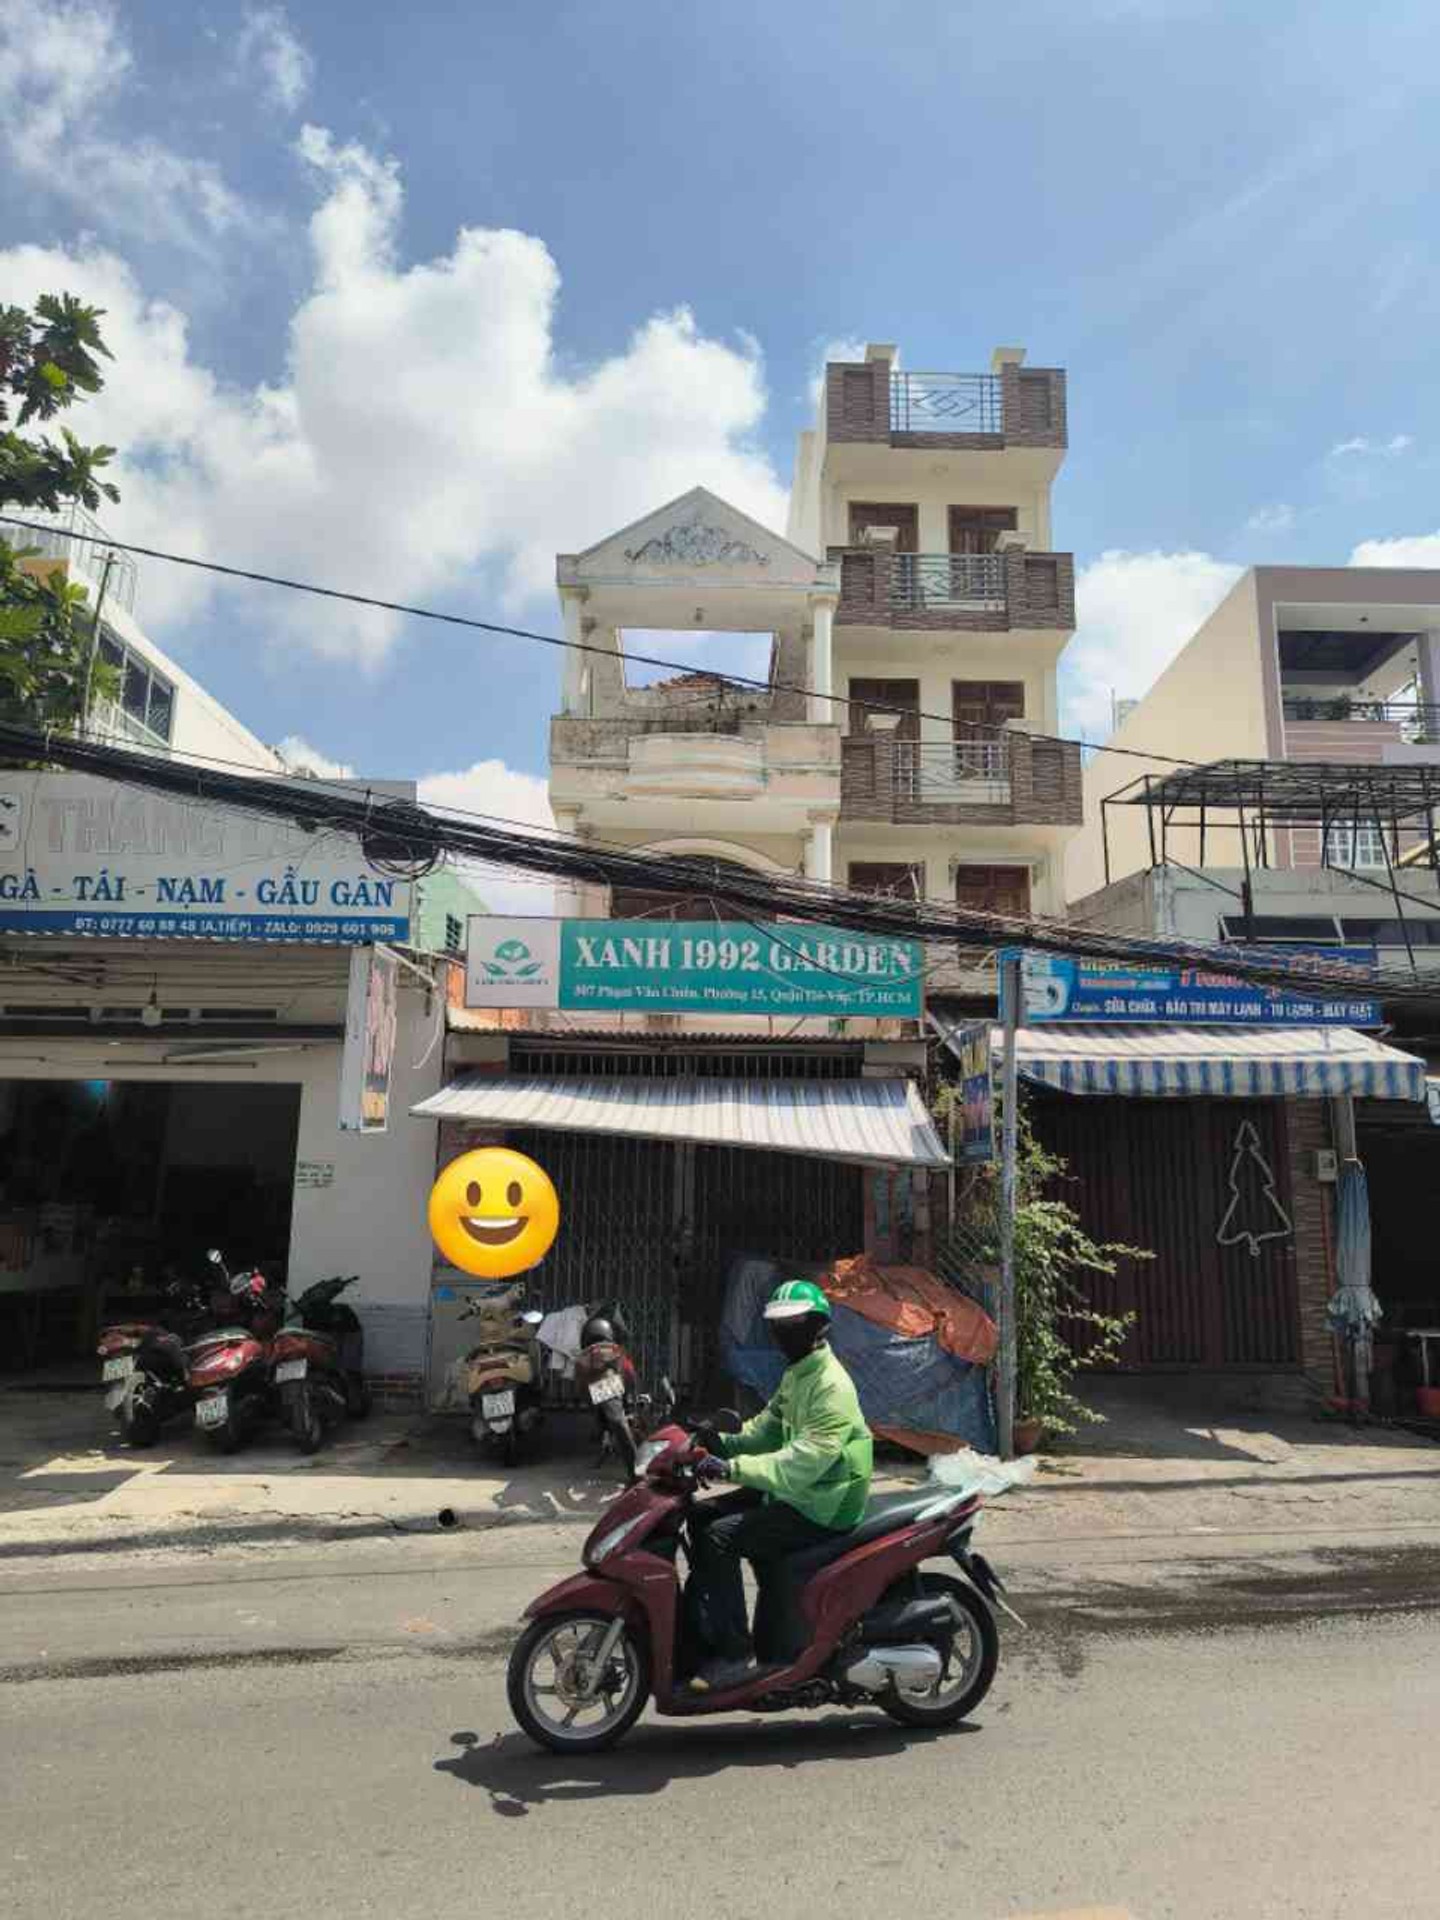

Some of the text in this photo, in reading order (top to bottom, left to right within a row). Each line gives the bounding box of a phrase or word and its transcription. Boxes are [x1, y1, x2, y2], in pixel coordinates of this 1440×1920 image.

[0, 868, 41, 899] GÀ
[72, 868, 126, 901] TÁI
[156, 877, 225, 909] NẠM
[330, 874, 396, 907] GÂN
[100, 917, 133, 932] 0777
[575, 937, 912, 975] XANH 1992 GARDEN
